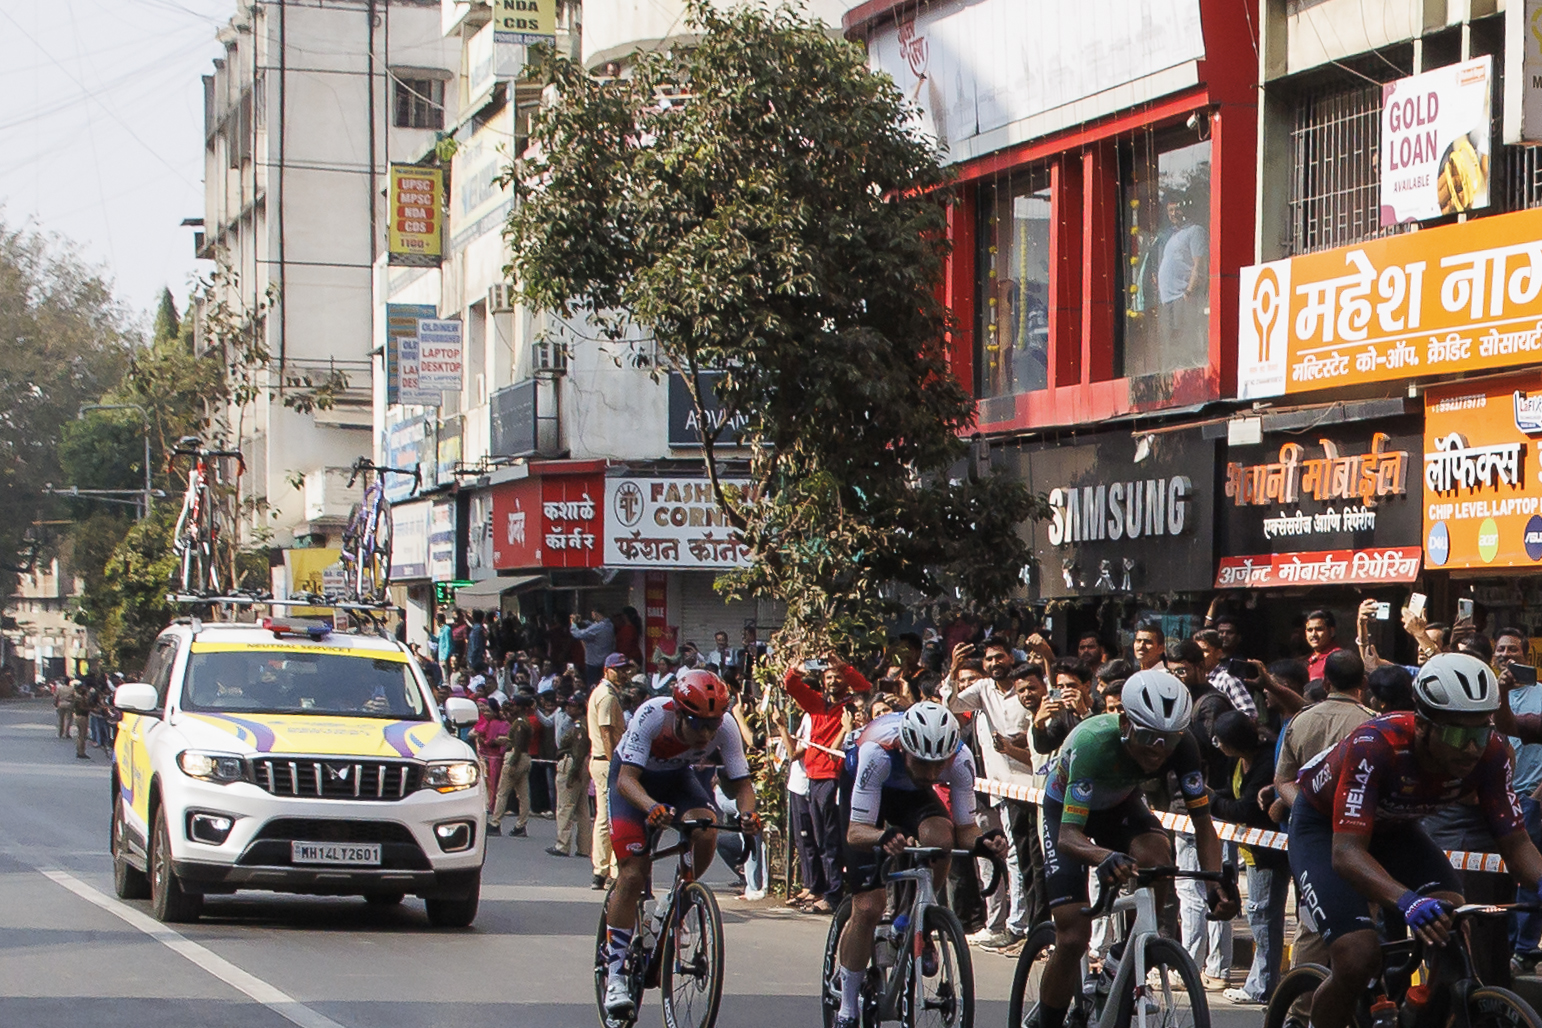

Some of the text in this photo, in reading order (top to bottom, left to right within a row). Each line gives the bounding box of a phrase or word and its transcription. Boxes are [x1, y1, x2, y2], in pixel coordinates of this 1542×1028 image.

[503, 0, 539, 12] NDA
[503, 17, 539, 30] CDS
[1389, 91, 1440, 134] GOLD
[1389, 129, 1438, 172] LOAN
[401, 179, 432, 191] UPSC
[1393, 174, 1430, 194] AVAILABLE
[400, 192, 432, 205] MPSC
[404, 207, 427, 219] NDA
[404, 221, 427, 233] CDS
[1295, 249, 1427, 343] महेश
[421, 348, 461, 359] LAPTOP
[1292, 351, 1350, 383] मल्टिस्टेट
[1426, 333, 1472, 364] क्रेडिट
[421, 361, 461, 373] DESKTOP
[1302, 432, 1409, 508] मोबाईल
[650, 482, 760, 504] FASHON
[543, 493, 596, 521] कशाळे
[653, 506, 741, 528] CORN
[1048, 475, 1191, 546] SAMSUNG
[1428, 503, 1454, 521] CHIP
[1455, 501, 1491, 519] LEVEL
[1492, 498, 1539, 518] LAPTOP
[1313, 507, 1342, 534] आणि
[544, 525, 596, 550] कॉर्नर
[1478, 535, 1498, 547] acer
[1278, 554, 1349, 582] मोबाईल
